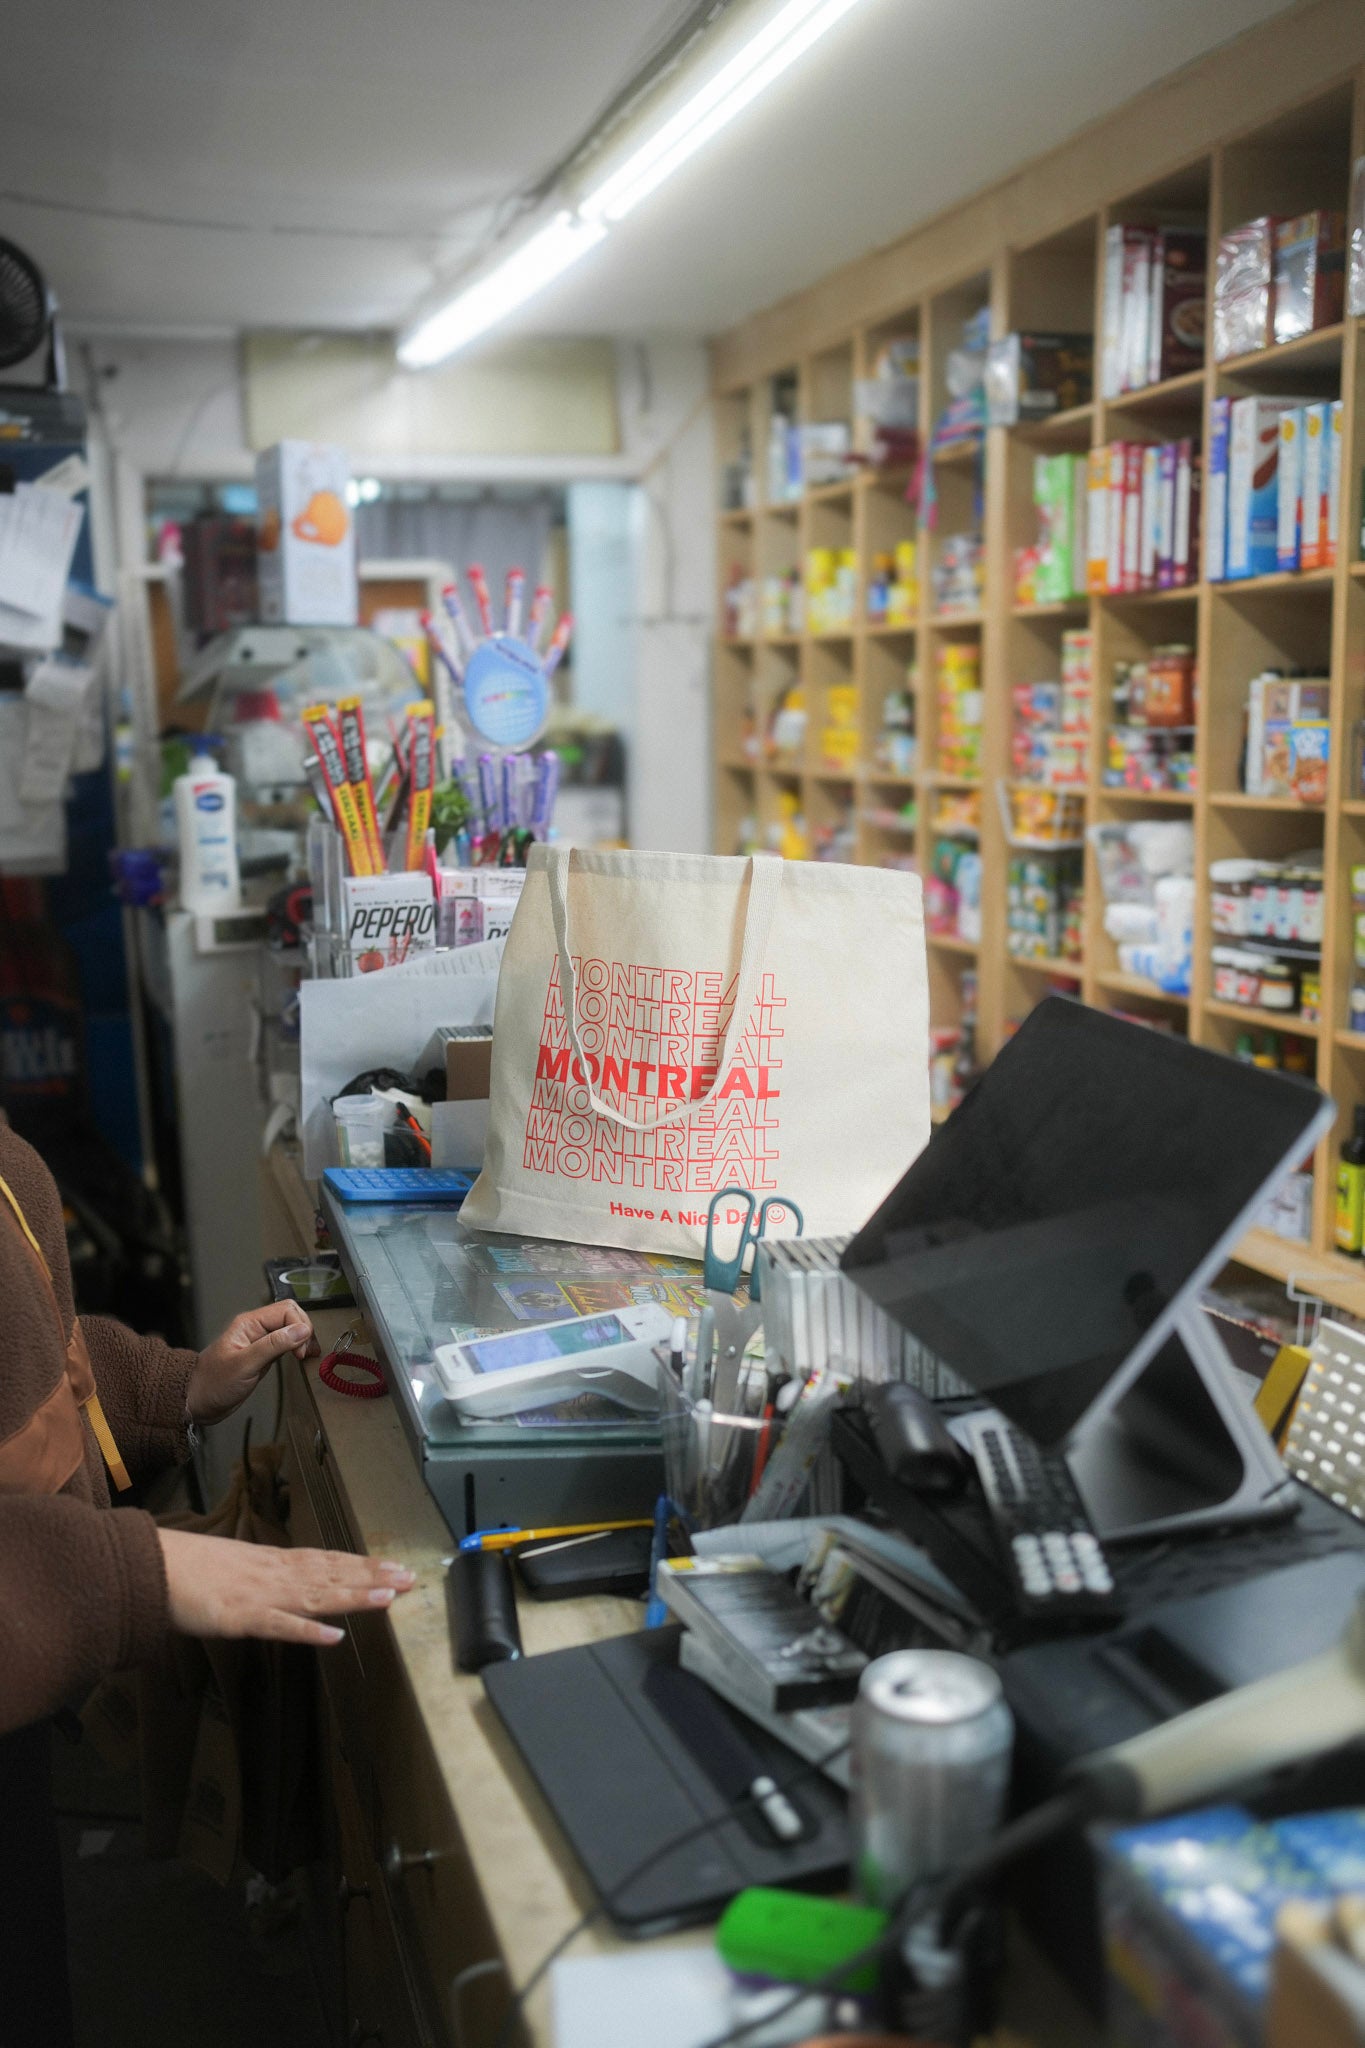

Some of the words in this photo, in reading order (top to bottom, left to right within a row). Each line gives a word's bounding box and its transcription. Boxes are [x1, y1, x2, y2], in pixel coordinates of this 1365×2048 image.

[350, 904, 433, 939] PEPERO
[539, 1015, 783, 1068] MONTREAL
[535, 1045, 780, 1099] MONTREAL
[531, 1078, 779, 1130] MONTREAL
[526, 1108, 779, 1161] MONTREAL
[523, 1138, 777, 1193] MONTREAL
[609, 1201, 655, 1220] Have
[659, 1209, 673, 1224] A
[678, 1211, 721, 1226] Nice
[726, 1208, 762, 1226] Day
